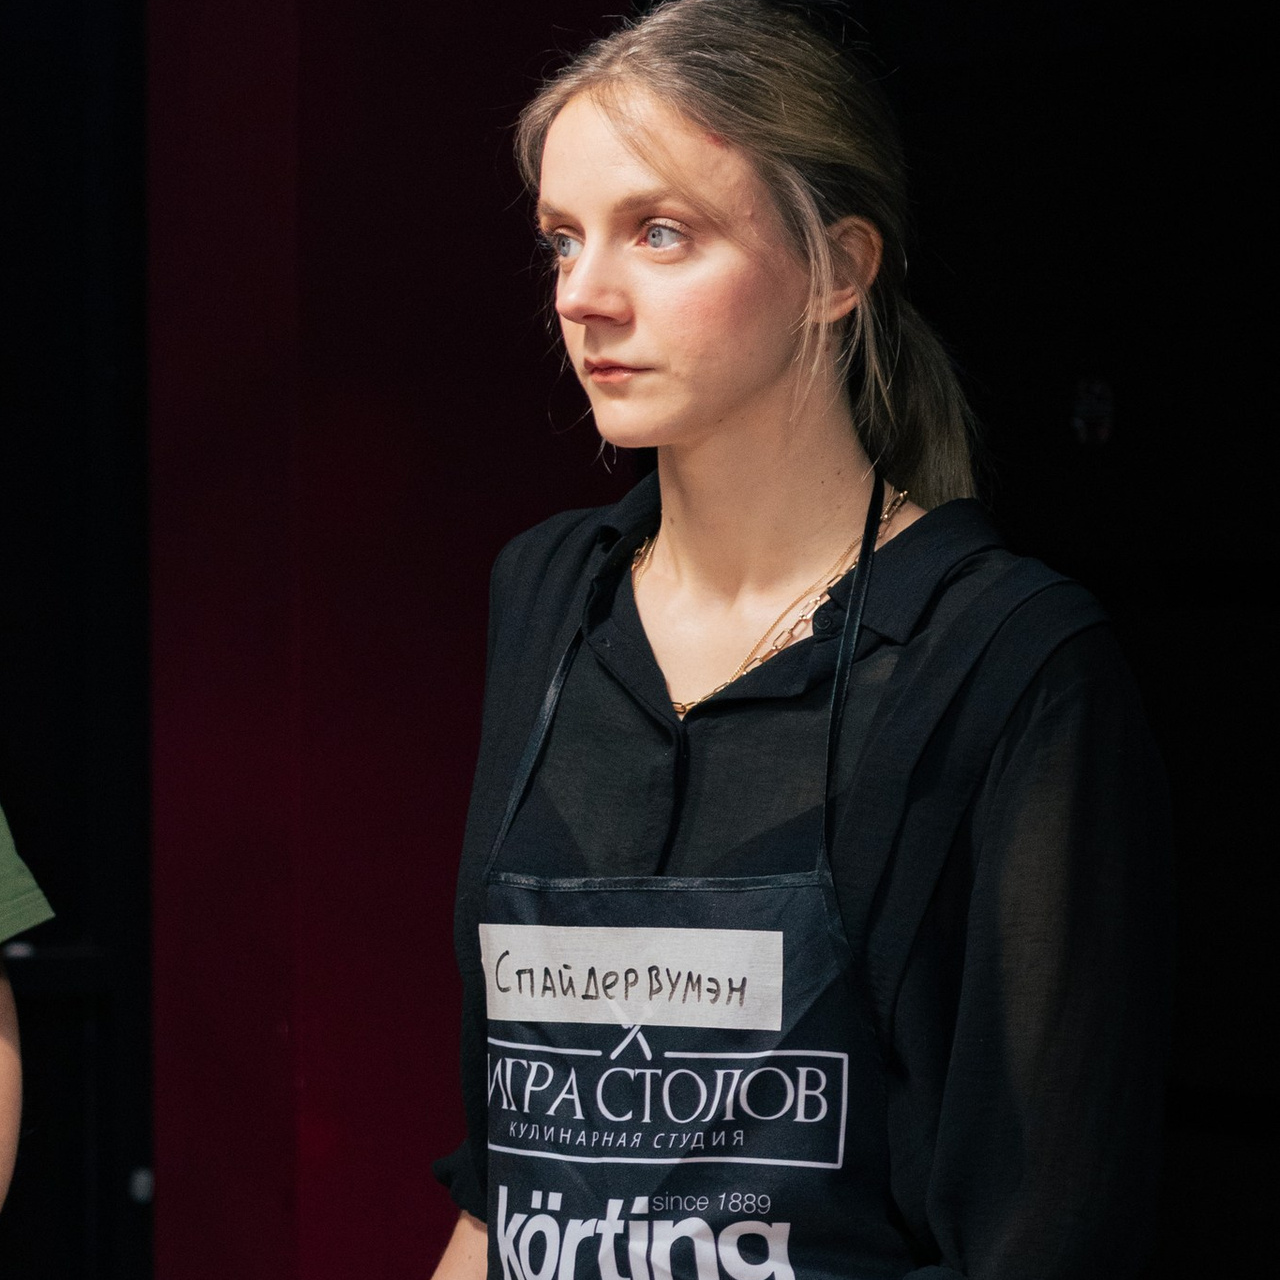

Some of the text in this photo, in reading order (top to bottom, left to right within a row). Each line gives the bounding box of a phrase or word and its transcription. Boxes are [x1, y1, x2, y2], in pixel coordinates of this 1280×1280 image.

[487, 1053, 828, 1123] ИГРА СТОЛОВ
[509, 1121, 745, 1150] КУЛИНАРНАЯ СТУДИЯ
[652, 1192, 771, 1214] since 1889
